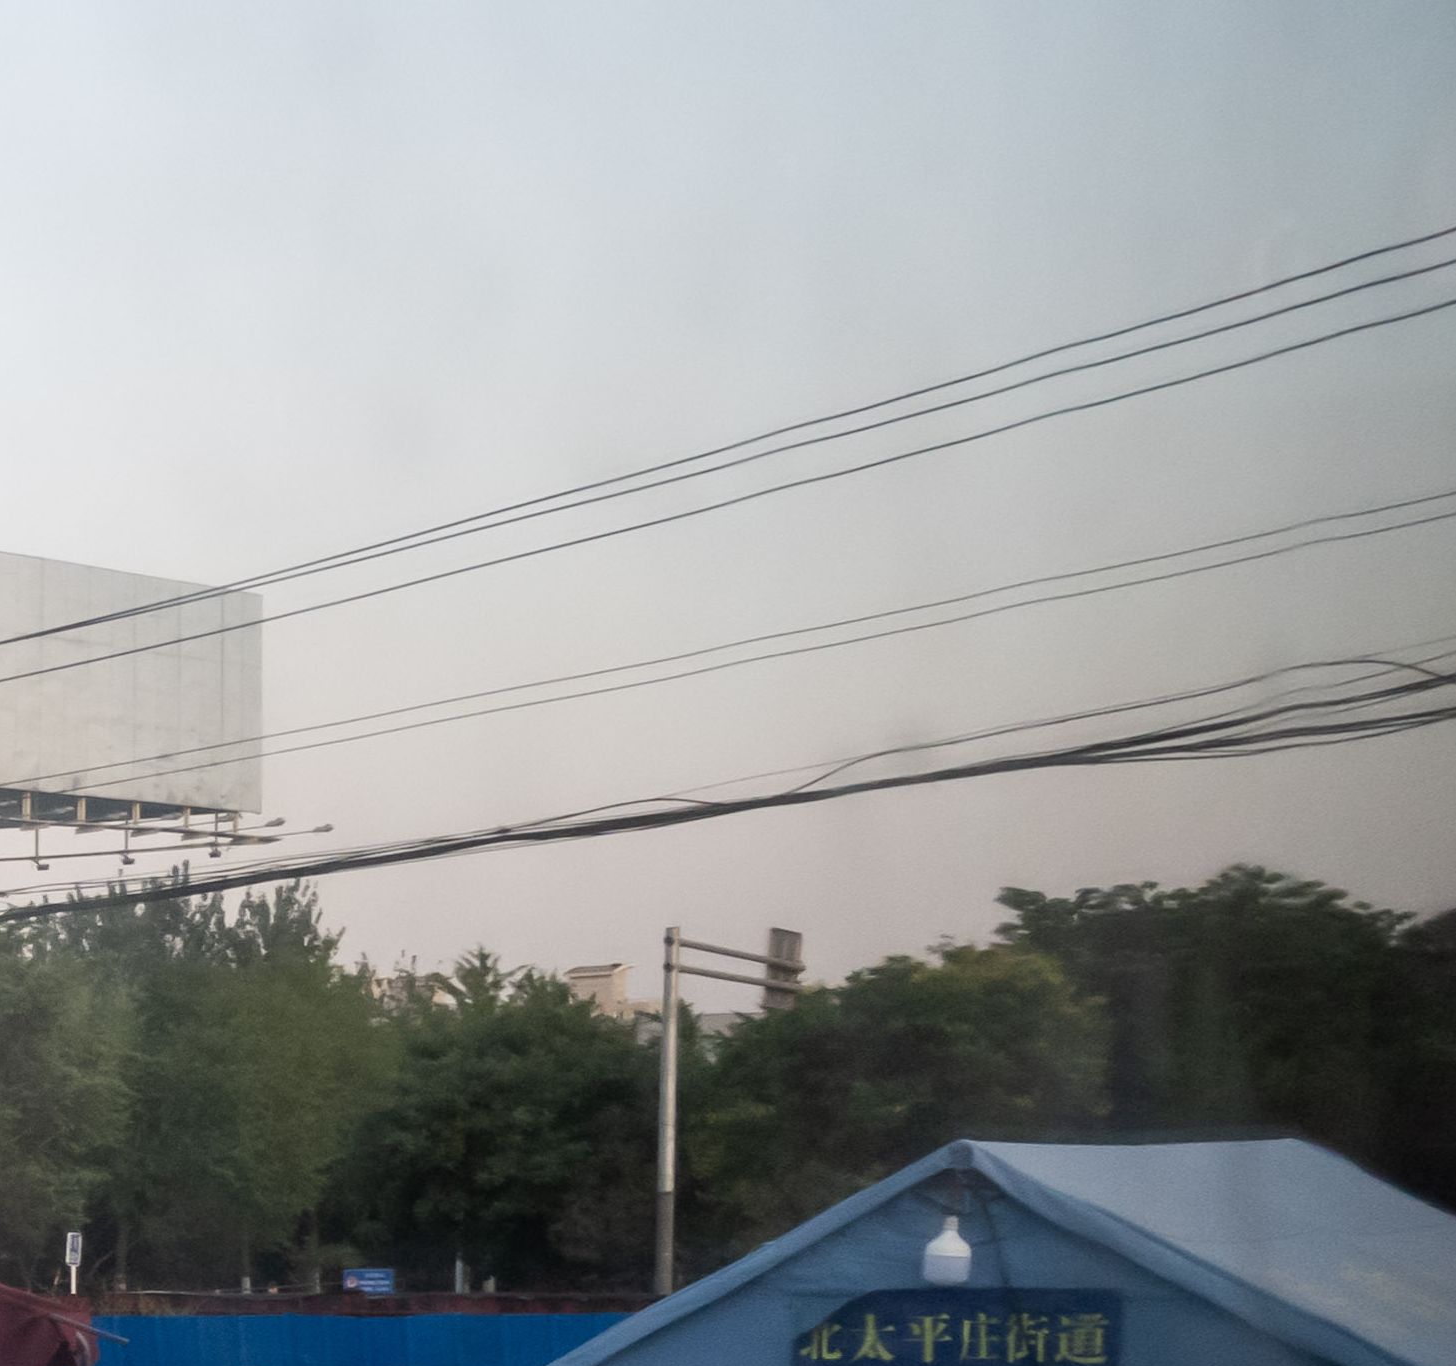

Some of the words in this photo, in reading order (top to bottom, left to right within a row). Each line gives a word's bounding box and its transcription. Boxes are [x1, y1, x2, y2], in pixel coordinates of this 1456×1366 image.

[799, 1313, 1110, 1365] 北太平庄街道
